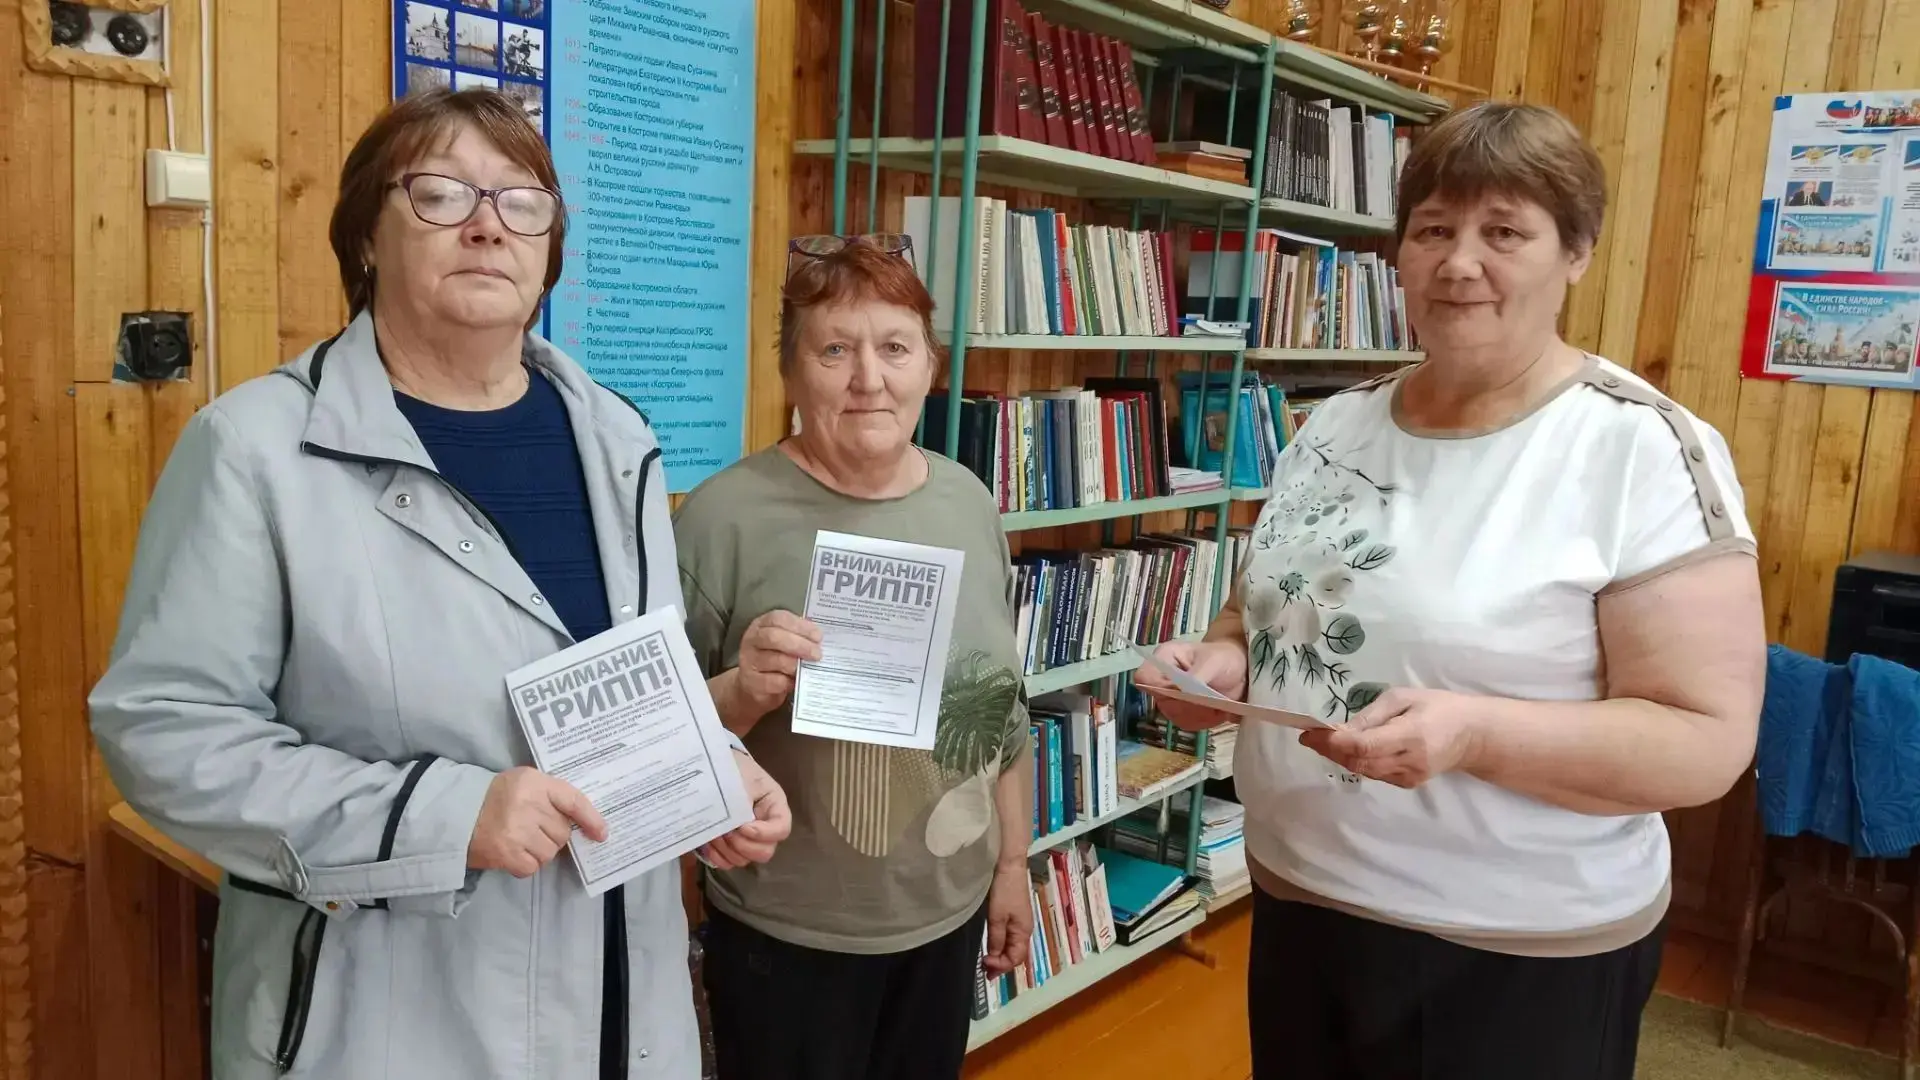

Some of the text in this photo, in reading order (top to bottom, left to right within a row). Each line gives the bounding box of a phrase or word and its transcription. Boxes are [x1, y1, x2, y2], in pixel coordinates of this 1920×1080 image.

[589, 14, 606, 24] царя
[607, 16, 637, 32] Михаила
[588, 102, 632, 119] Образование
[588, 118, 621, 132] Открытие
[604, 164, 642, 178] Островский
[594, 179, 625, 191] Костроме
[644, 214, 674, 227] Костроме
[621, 238, 648, 249] Великой
[587, 279, 630, 292] Образование
[1802, 293, 1807, 302] В
[1809, 294, 1848, 304] ЕДИНСТВЕ
[1849, 296, 1883, 305] НАРОДОВ
[1816, 304, 1835, 312] СИЛА
[820, 552, 937, 583] ВНИМАНИЕ
[817, 568, 934, 607] ГРИПП!
[521, 639, 662, 708] ВНИМАНИЕ
[528, 658, 672, 737] ГРИПП!
